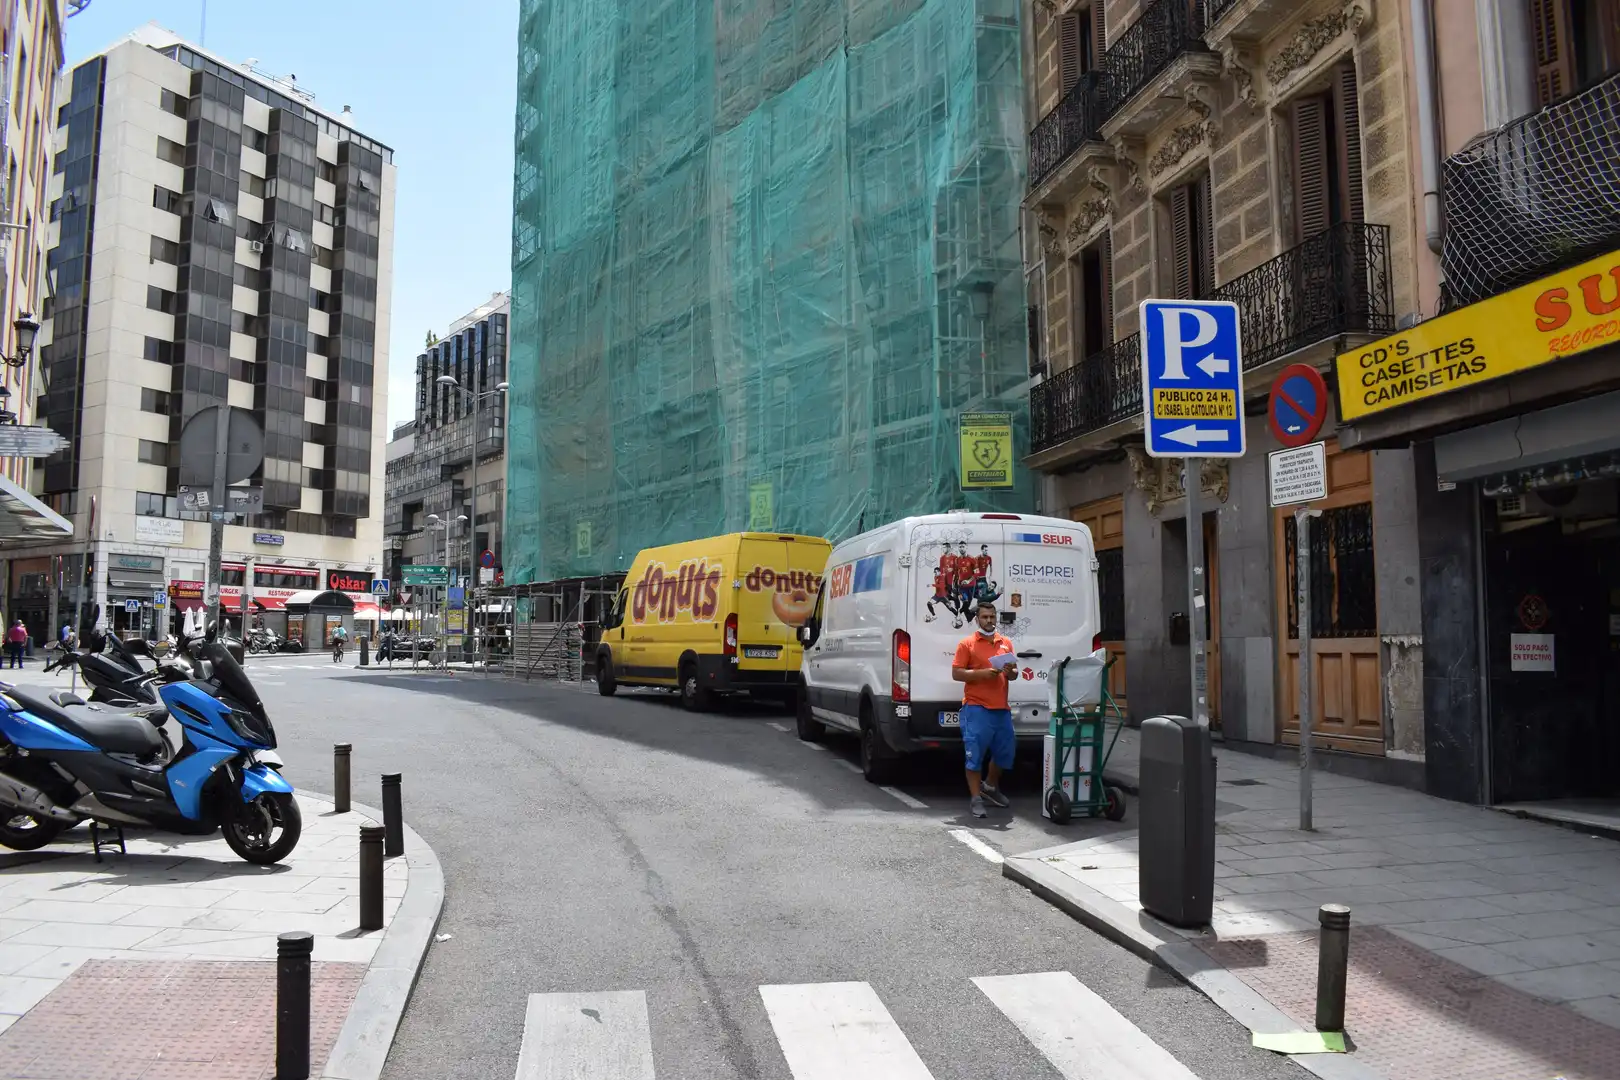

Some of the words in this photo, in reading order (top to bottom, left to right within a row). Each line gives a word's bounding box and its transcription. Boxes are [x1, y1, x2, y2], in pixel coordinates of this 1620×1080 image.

[1157, 307, 1219, 380] P
[1548, 320, 1620, 354] RECORD
[1359, 339, 1409, 369] CD'S
[1361, 337, 1475, 388] CASETTES
[1363, 355, 1487, 406] CAMISETAS
[1159, 391, 1203, 402] PUBLICO
[1206, 391, 1218, 402] 24
[1221, 391, 1231, 402] H.
[1164, 404, 1184, 416] ISABEL
[1042, 533, 1073, 546] SEUR
[329, 573, 366, 591] Oskar
[830, 564, 852, 601] SEUR
[1008, 564, 1074, 578] ¡SIEMPRE!
[632, 558, 722, 623] donuts
[1523, 653, 1552, 661] EFECTIVO
[945, 713, 959, 723] 26
